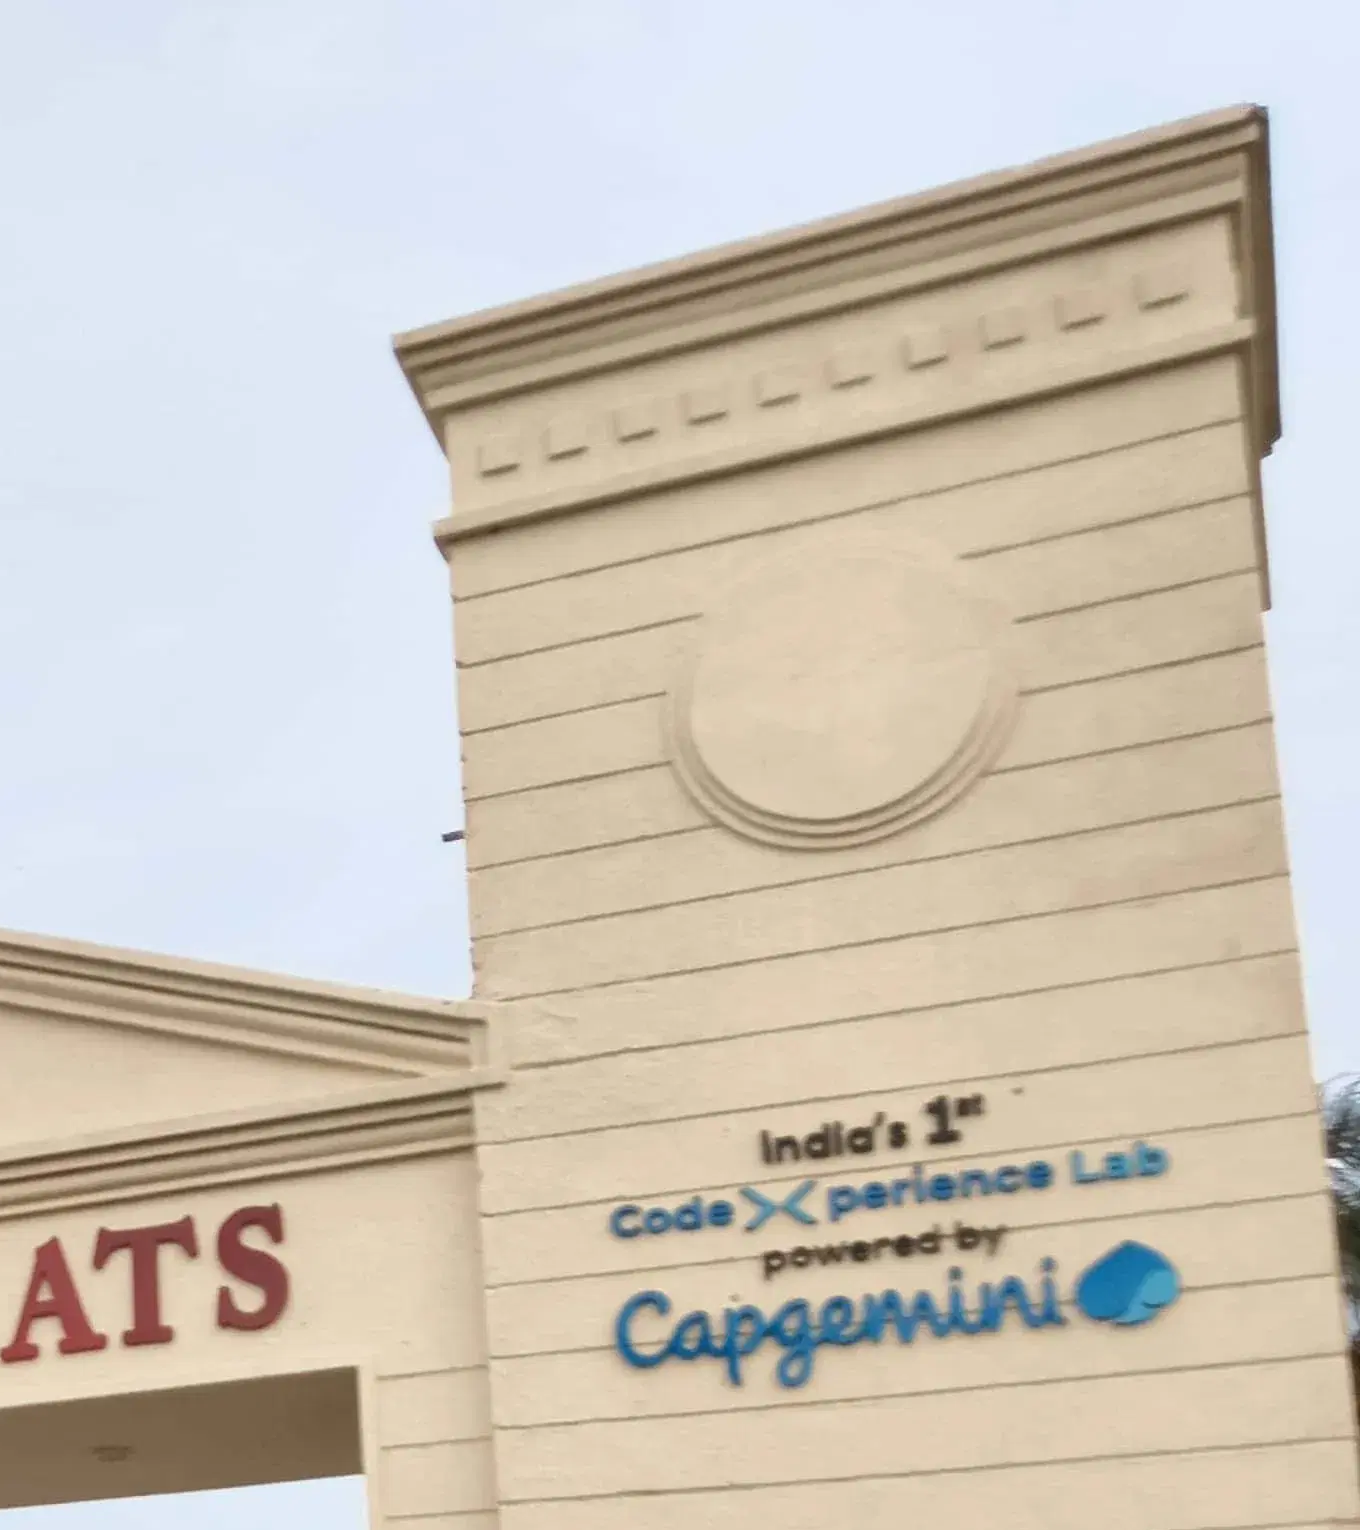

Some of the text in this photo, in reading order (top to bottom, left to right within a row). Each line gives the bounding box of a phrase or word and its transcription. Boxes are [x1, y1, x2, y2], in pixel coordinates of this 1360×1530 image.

[760, 1111, 908, 1164] India's
[1070, 1140, 1170, 1184] Lab
[762, 1219, 1011, 1280] powered by
[615, 1257, 1068, 1389] Capgemini
